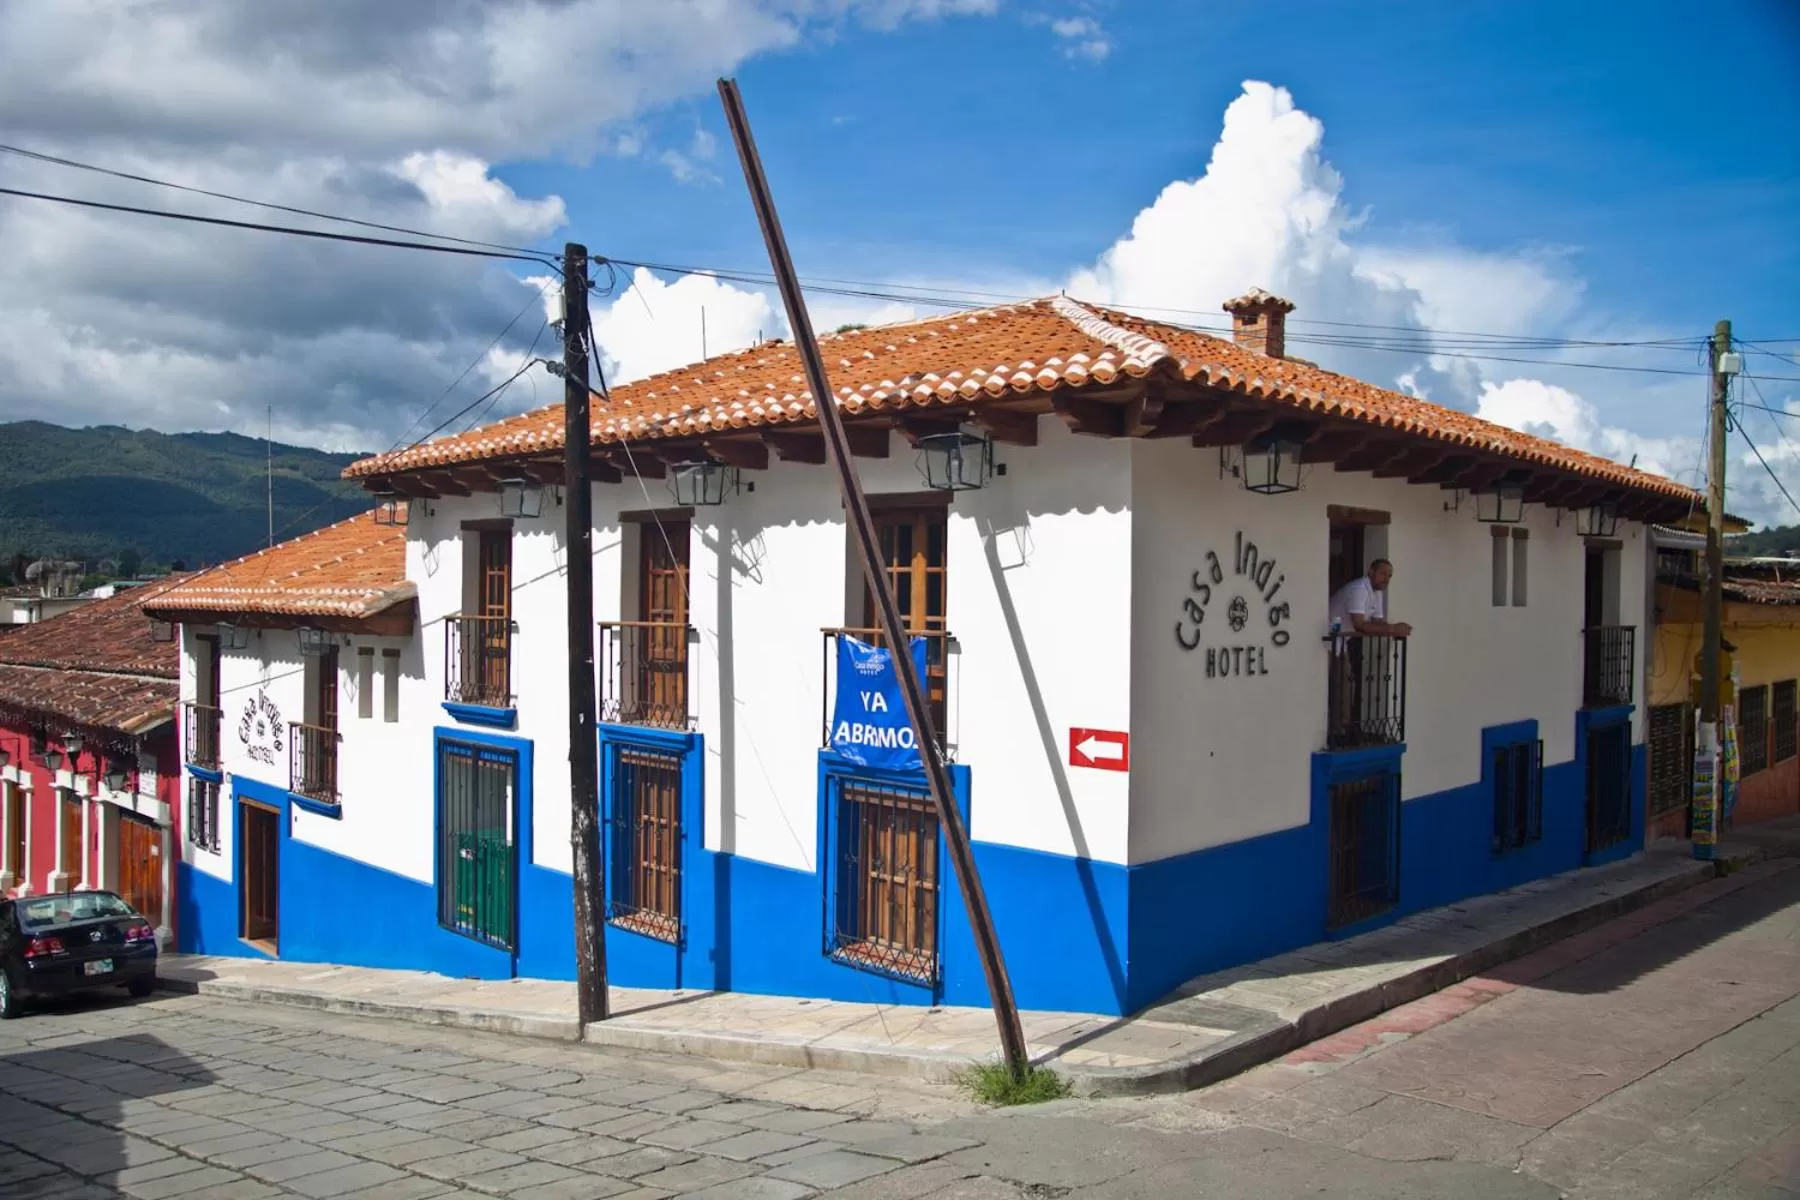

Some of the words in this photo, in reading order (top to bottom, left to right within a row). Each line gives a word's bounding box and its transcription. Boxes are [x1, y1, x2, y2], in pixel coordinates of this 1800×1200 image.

[1175, 550, 1223, 650] Casa
[1235, 531, 1290, 646] Indigo
[1206, 646, 1268, 678] HOTEL
[860, 691, 888, 712] YA
[833, 719, 919, 749] ABRIMO
